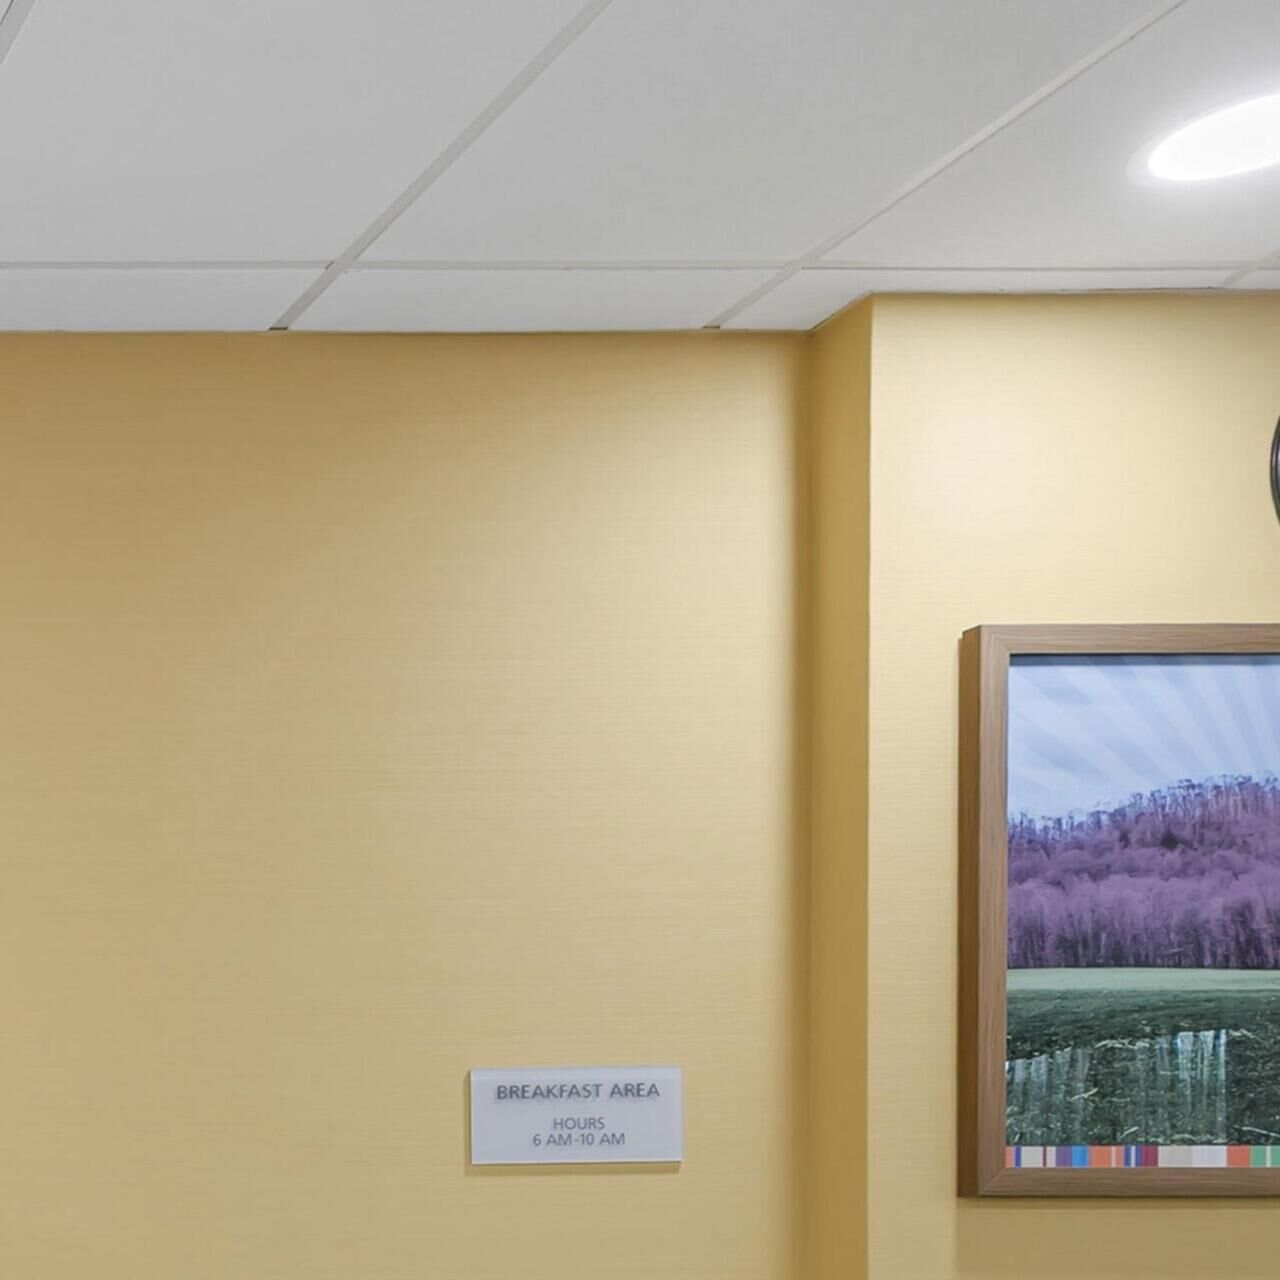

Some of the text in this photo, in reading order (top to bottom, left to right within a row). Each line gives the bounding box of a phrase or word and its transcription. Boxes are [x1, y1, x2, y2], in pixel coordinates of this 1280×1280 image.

[496, 1082, 660, 1100] BREAKFAST AREA
[553, 1117, 606, 1130] HOURS
[533, 1133, 542, 1146] 6
[600, 1132, 626, 1145] AM
